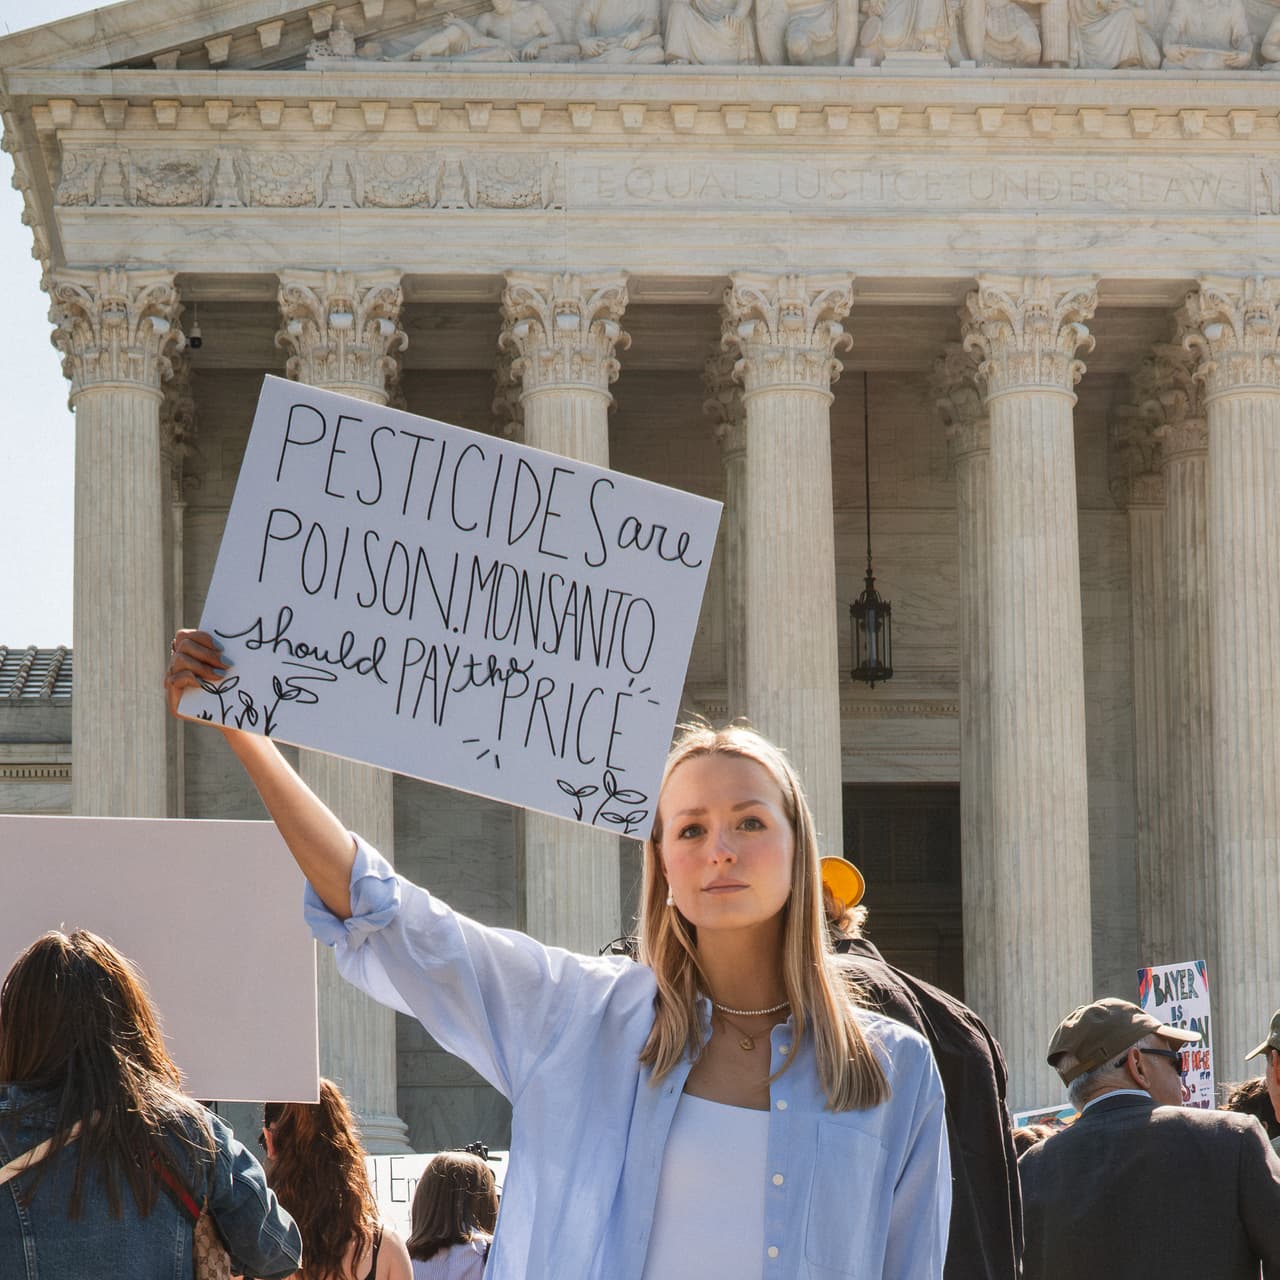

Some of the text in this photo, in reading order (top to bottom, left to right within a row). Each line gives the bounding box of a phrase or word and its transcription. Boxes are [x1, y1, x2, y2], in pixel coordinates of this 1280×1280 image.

[596, 166, 1221, 203] EQUAL JUSTICE UNDER LAW
[276, 404, 703, 568] PESTICIDES are
[214, 606, 634, 772] should PAY the PRICE
[1152, 968, 1199, 1007] BAYER
[1171, 1004, 1183, 1022] IS
